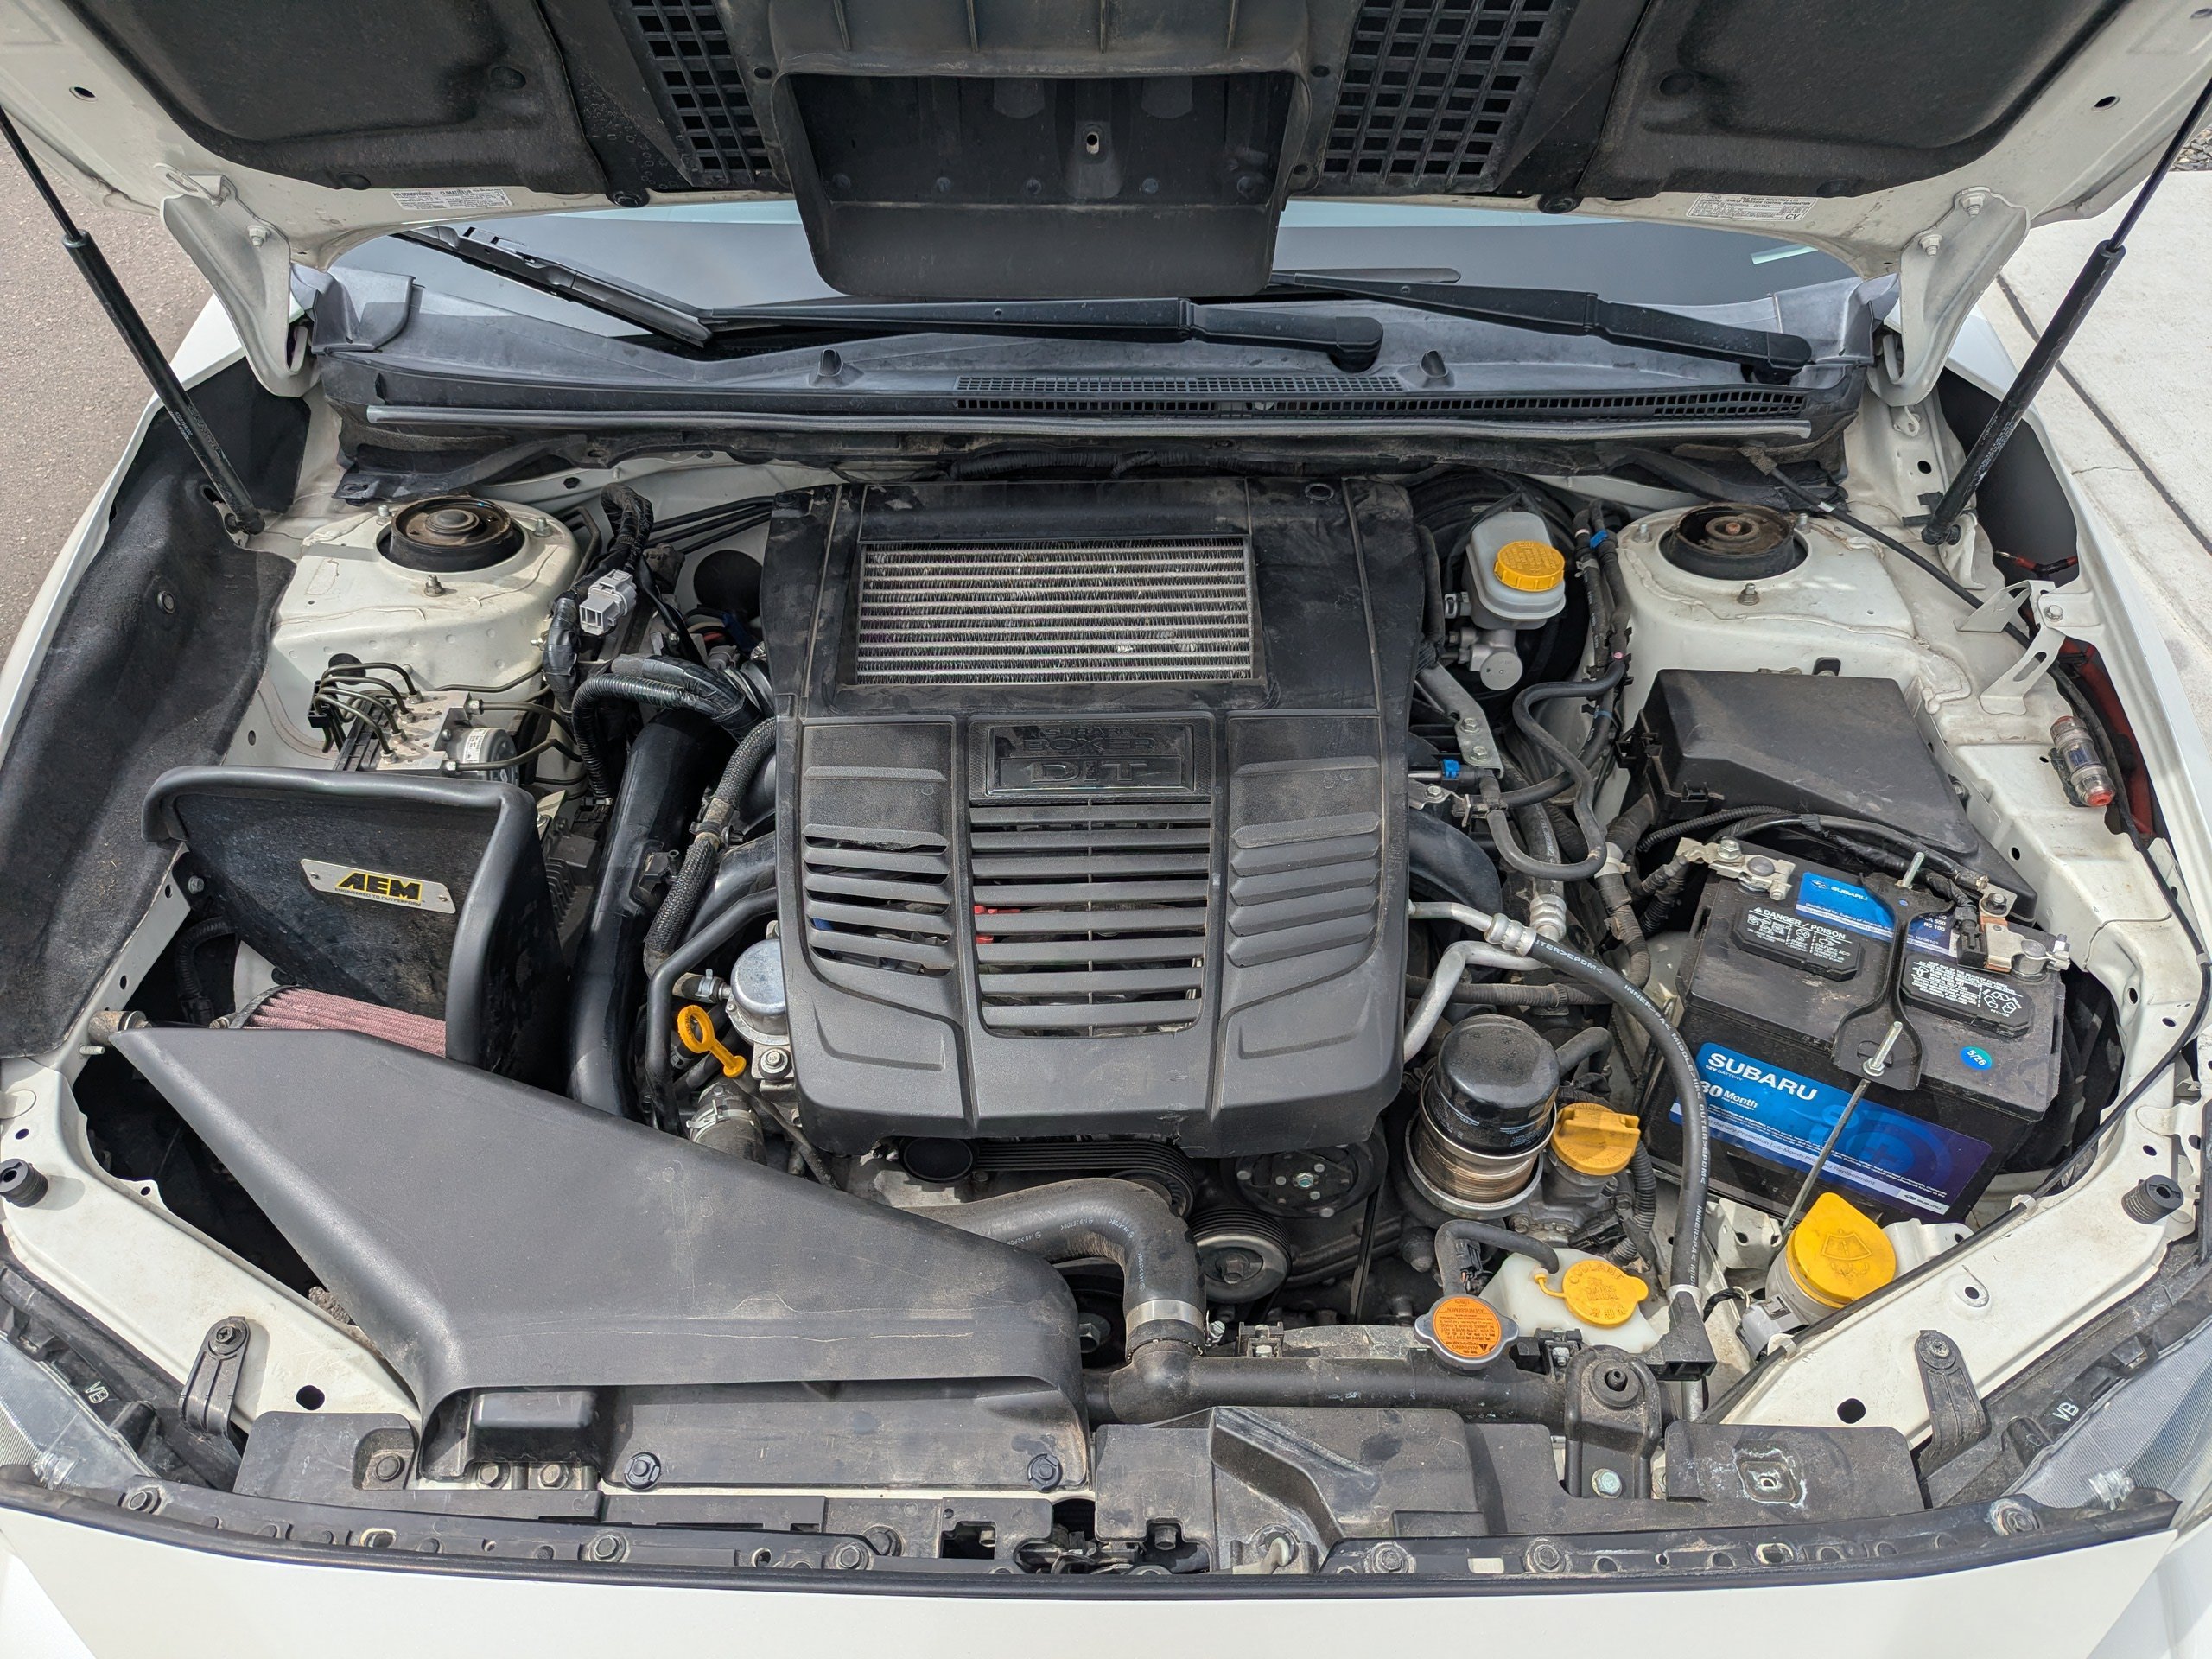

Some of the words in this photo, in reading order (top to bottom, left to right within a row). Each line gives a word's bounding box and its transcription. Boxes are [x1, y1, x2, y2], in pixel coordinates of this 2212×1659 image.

[1046, 727, 1135, 735] SUBARU
[1024, 737, 1156, 752] BOXER
[1031, 760, 1148, 783] DIT
[336, 872, 423, 901] AEM
[1830, 886, 1868, 901] SUBARU
[334, 887, 372, 898] ENGINEERED
[381, 896, 422, 906] OUTPERFORM
[1764, 909, 1802, 926] DANGER
[1810, 925, 1847, 940] POISON
[1815, 942, 1838, 952] SULFURIC
[1967, 1050, 1987, 1065] 5/26
[1707, 1052, 1818, 1101] SUBARU
[1717, 1070, 1743, 1082] BATTERY
[1700, 1080, 1724, 1098] 30
[1723, 1090, 1758, 1109] Month
[1713, 1121, 1736, 1133] Battery
[1736, 1128, 1770, 1145] Protection
[1832, 1166, 1876, 1185] Replacement
[1916, 1198, 1942, 1211] SUBARU
[1691, 1205, 1703, 1261] INNER>PA<
[1444, 1305, 1484, 1314] AVERTISSEMENT
[85, 1380, 109, 1404] VB
[2052, 1402, 2079, 1421] VB
